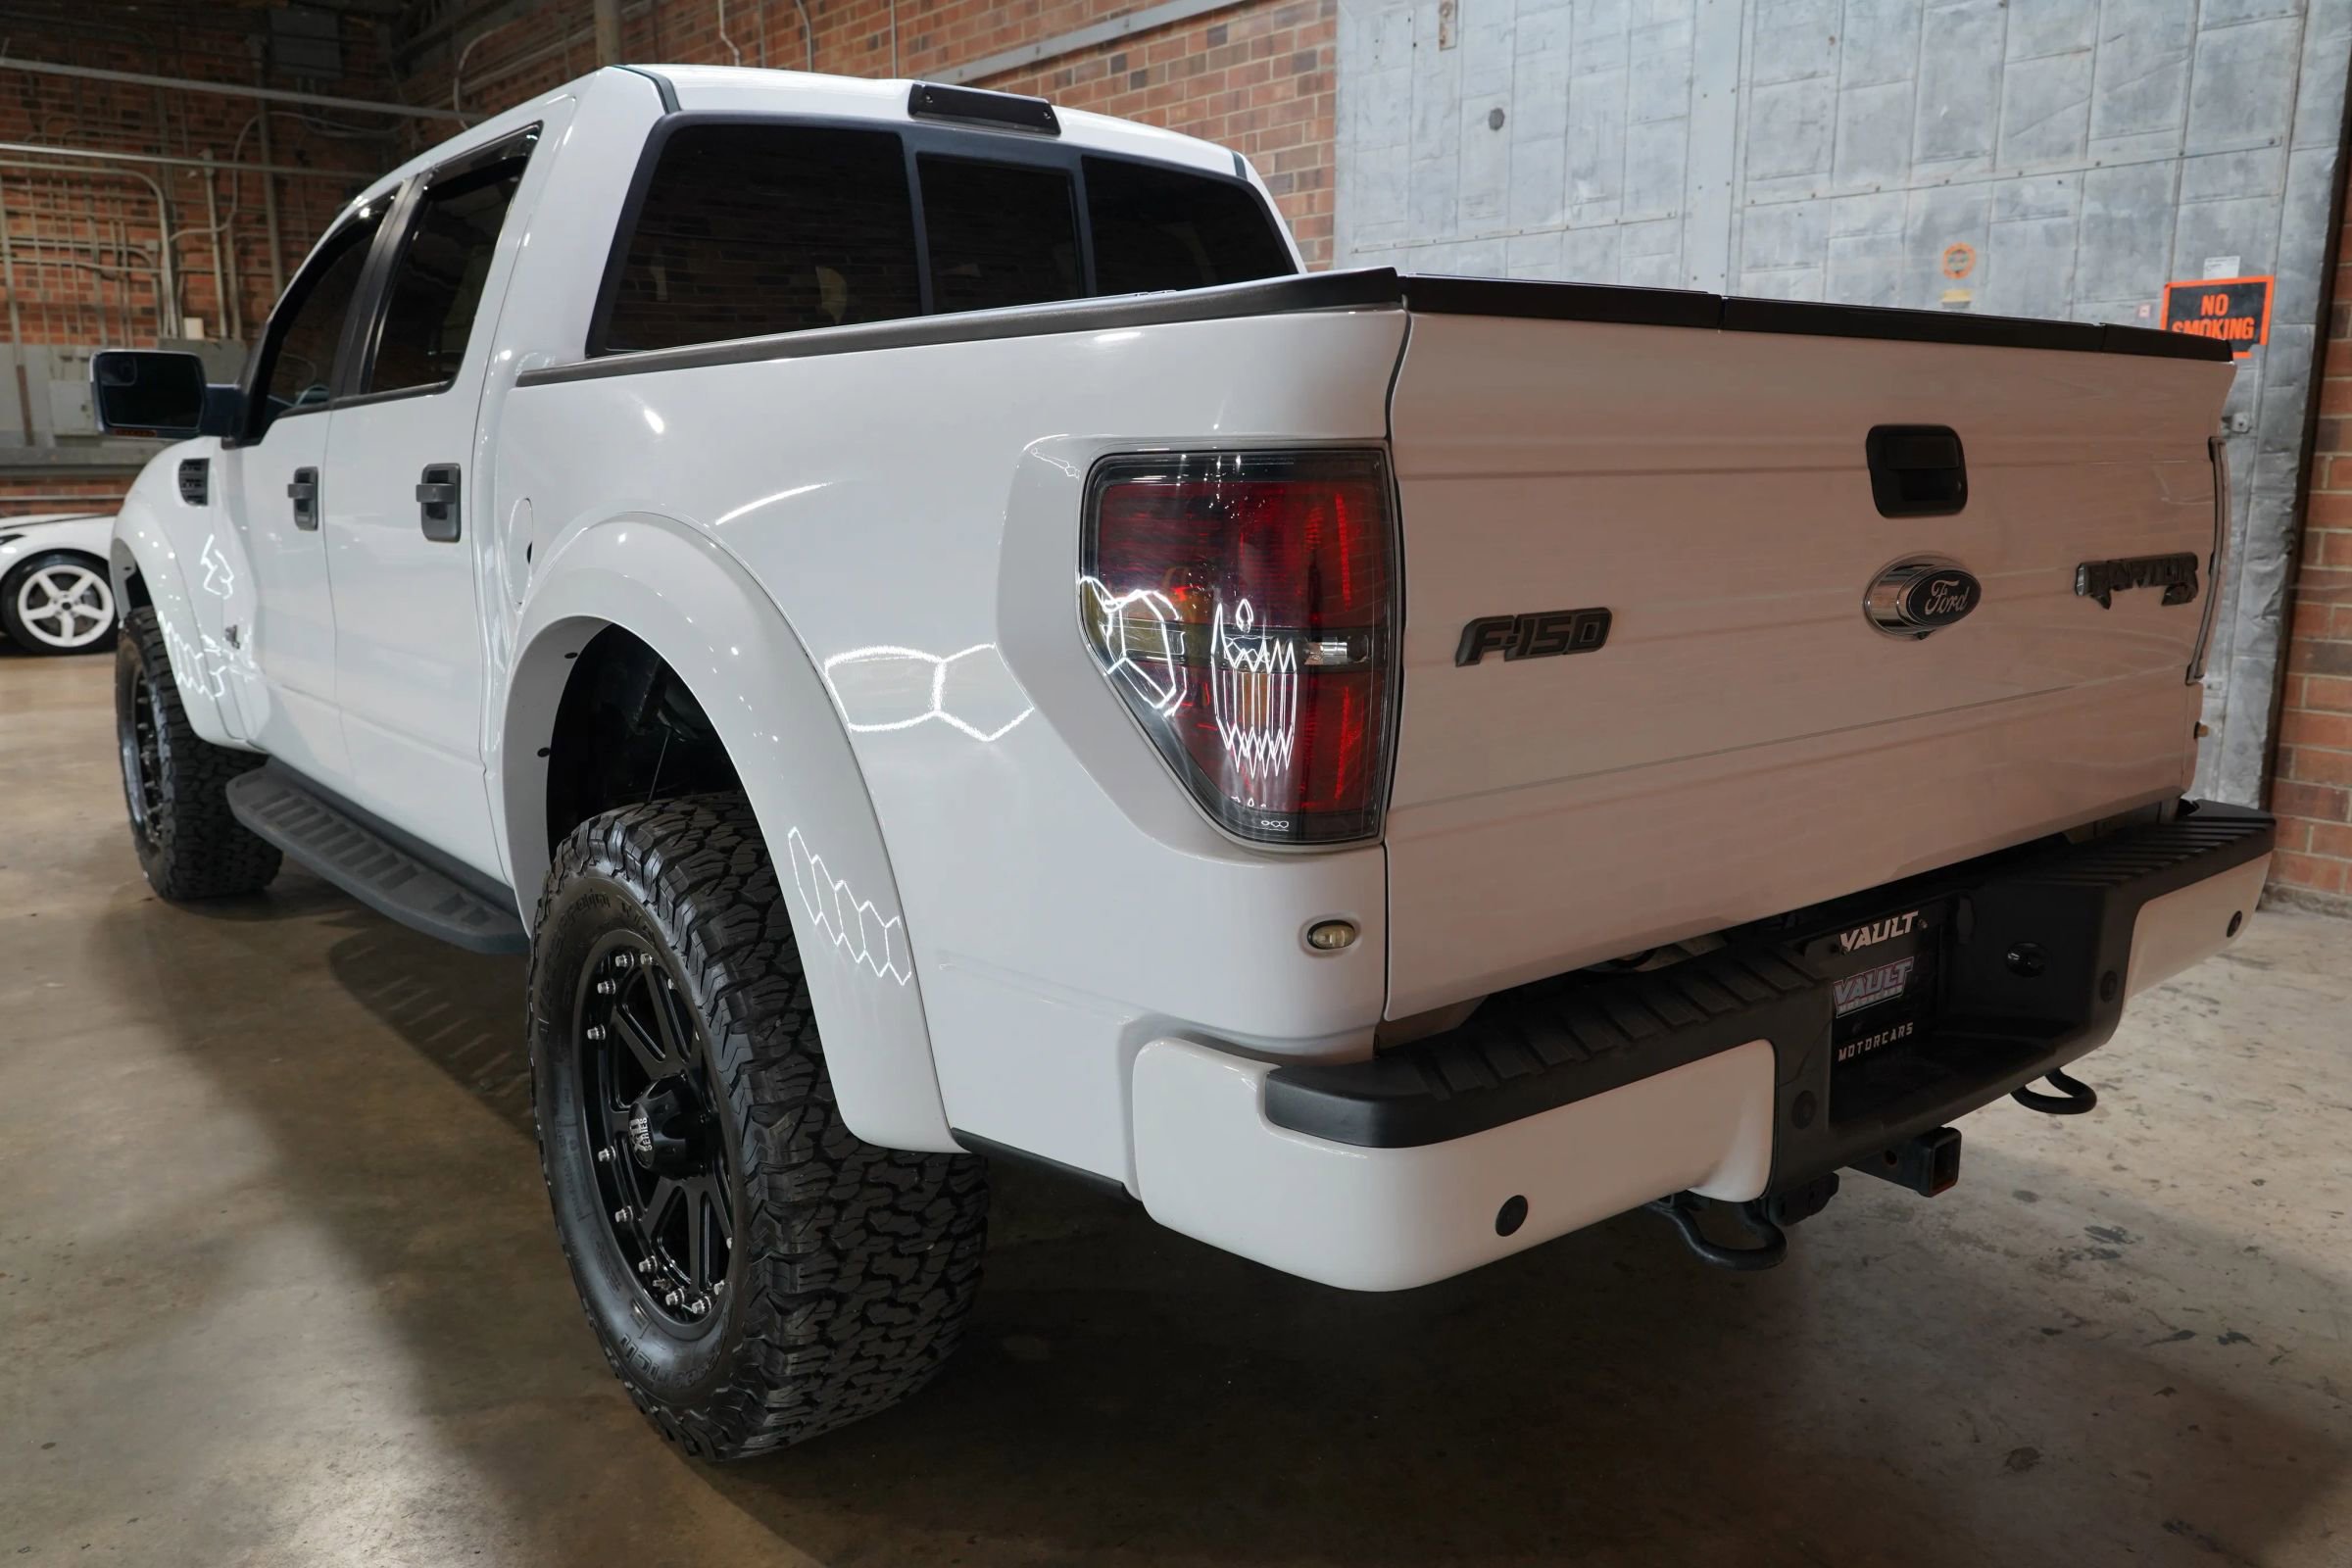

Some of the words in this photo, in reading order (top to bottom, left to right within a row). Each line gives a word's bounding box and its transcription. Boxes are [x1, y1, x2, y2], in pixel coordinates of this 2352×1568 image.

[2200, 293, 2230, 317] NO
[1924, 579, 1971, 615] Ford
[1455, 607, 1613, 667] F-150
[1839, 910, 1919, 954] VAULT
[1834, 957, 1913, 1006] VAULT
[1838, 1022, 1914, 1062] MOTORCARS
[639, 1117, 654, 1152] SERIES
